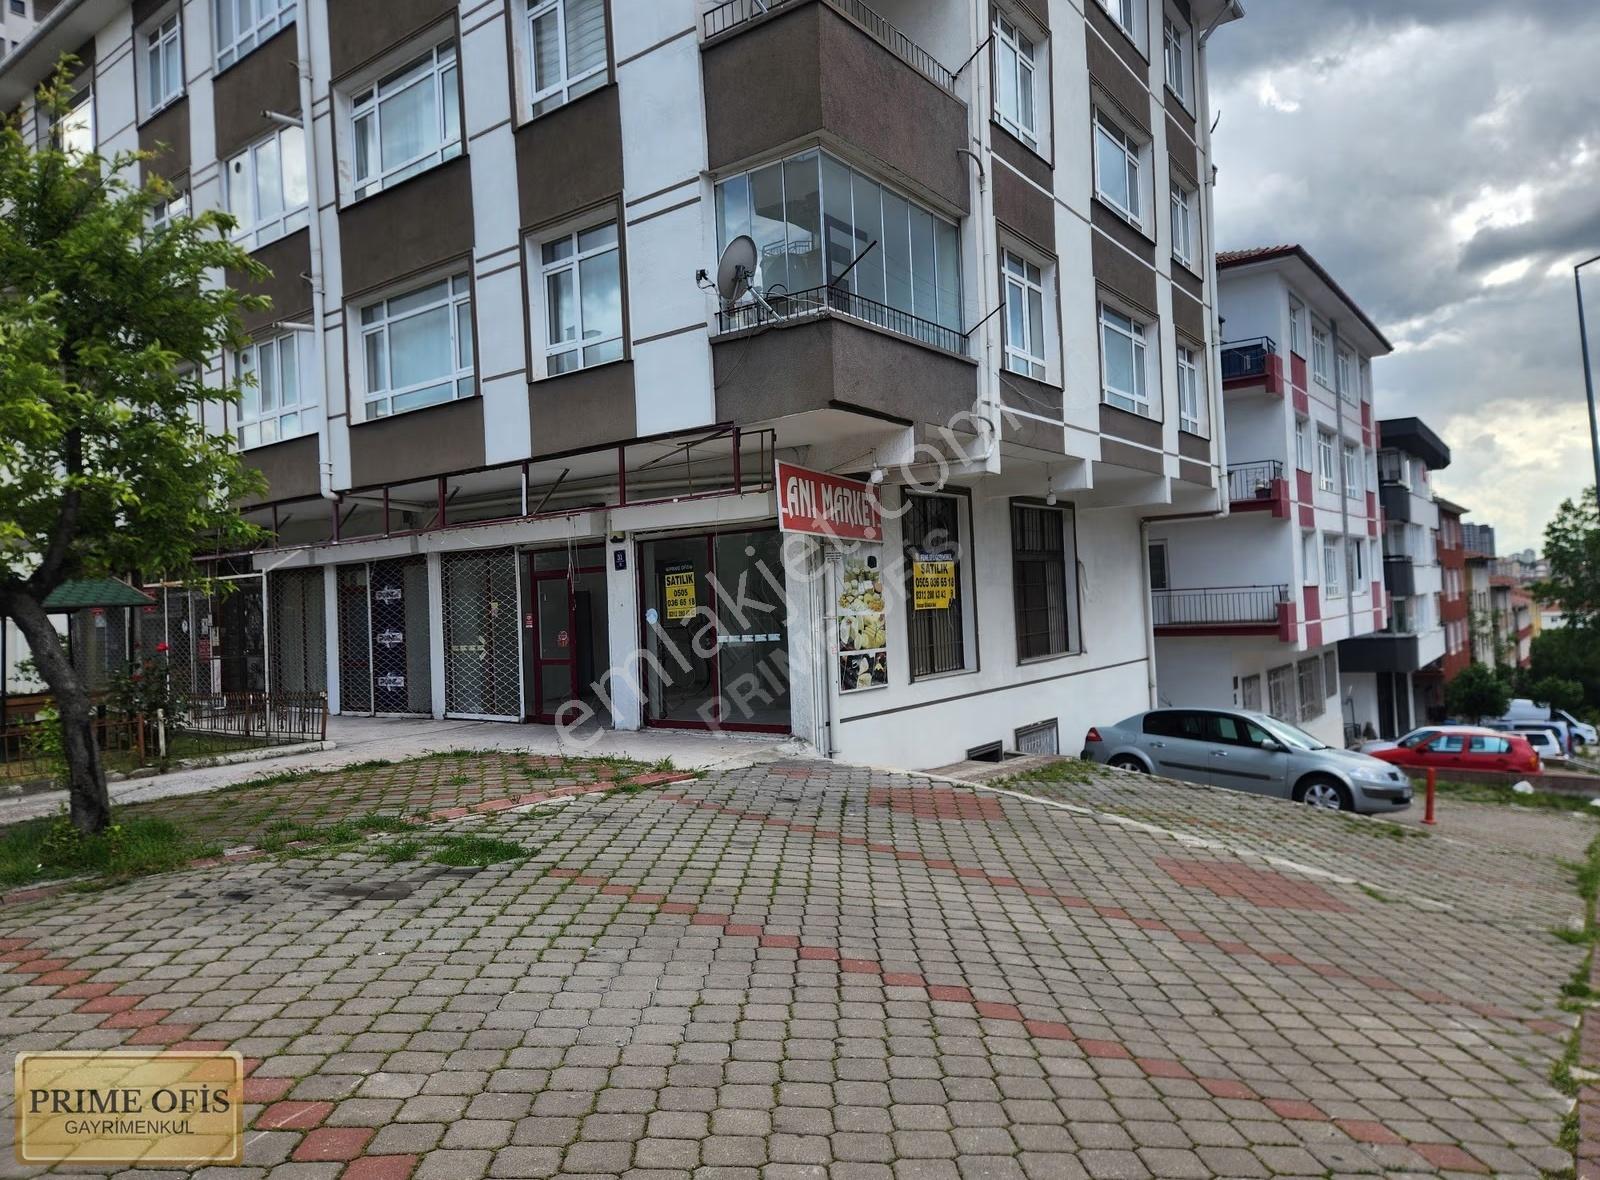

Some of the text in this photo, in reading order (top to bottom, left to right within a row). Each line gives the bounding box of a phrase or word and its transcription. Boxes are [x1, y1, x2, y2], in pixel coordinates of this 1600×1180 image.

[786, 475, 817, 519] ANI
[920, 563, 949, 575] SATILIK
[666, 574, 694, 587] SATILIK
[673, 588, 688, 598] 0505
[667, 599, 679, 607] 036
